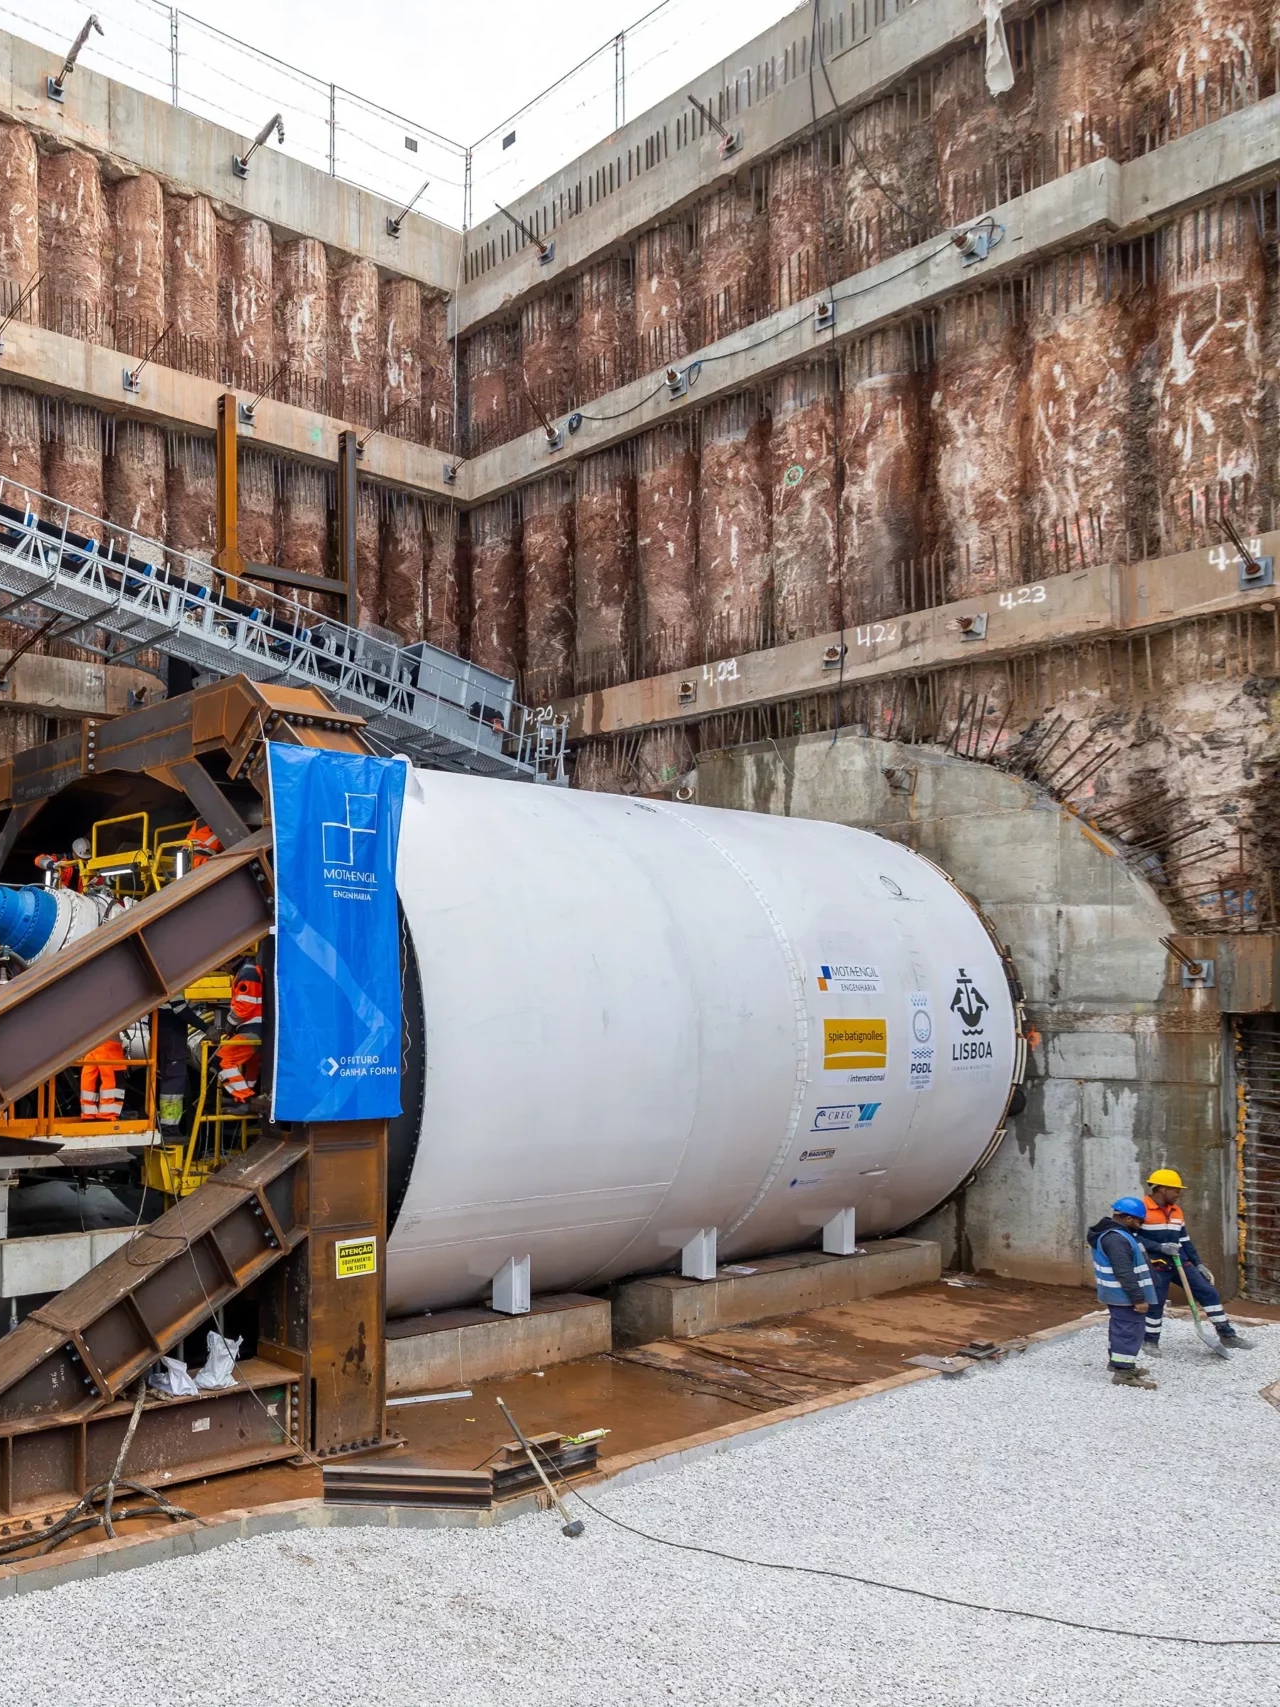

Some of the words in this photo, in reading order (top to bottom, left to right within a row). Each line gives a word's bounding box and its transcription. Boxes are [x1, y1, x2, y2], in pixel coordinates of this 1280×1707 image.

[999, 585, 1047, 610] 4.23
[856, 622, 898, 647] 4.22
[524, 704, 554, 726] 4.20
[333, 890, 372, 901] ENGENHARIA
[840, 983, 877, 992] ENGENHARIA
[828, 1030, 844, 1044] spie
[844, 1030, 884, 1044] batignolles
[952, 1041, 993, 1061] LISBOA
[340, 1056, 347, 1065] O
[347, 1055, 380, 1065] FUTURO
[340, 1068, 368, 1077] GANHA
[370, 1066, 398, 1076] FORMA
[910, 1062, 932, 1074] PGDL
[827, 1110, 854, 1121] CREG
[340, 1245, 373, 1257] ATENÇÃO
[341, 1256, 372, 1266] EQUIPAMENTO
[354, 1263, 367, 1271] TESTE
